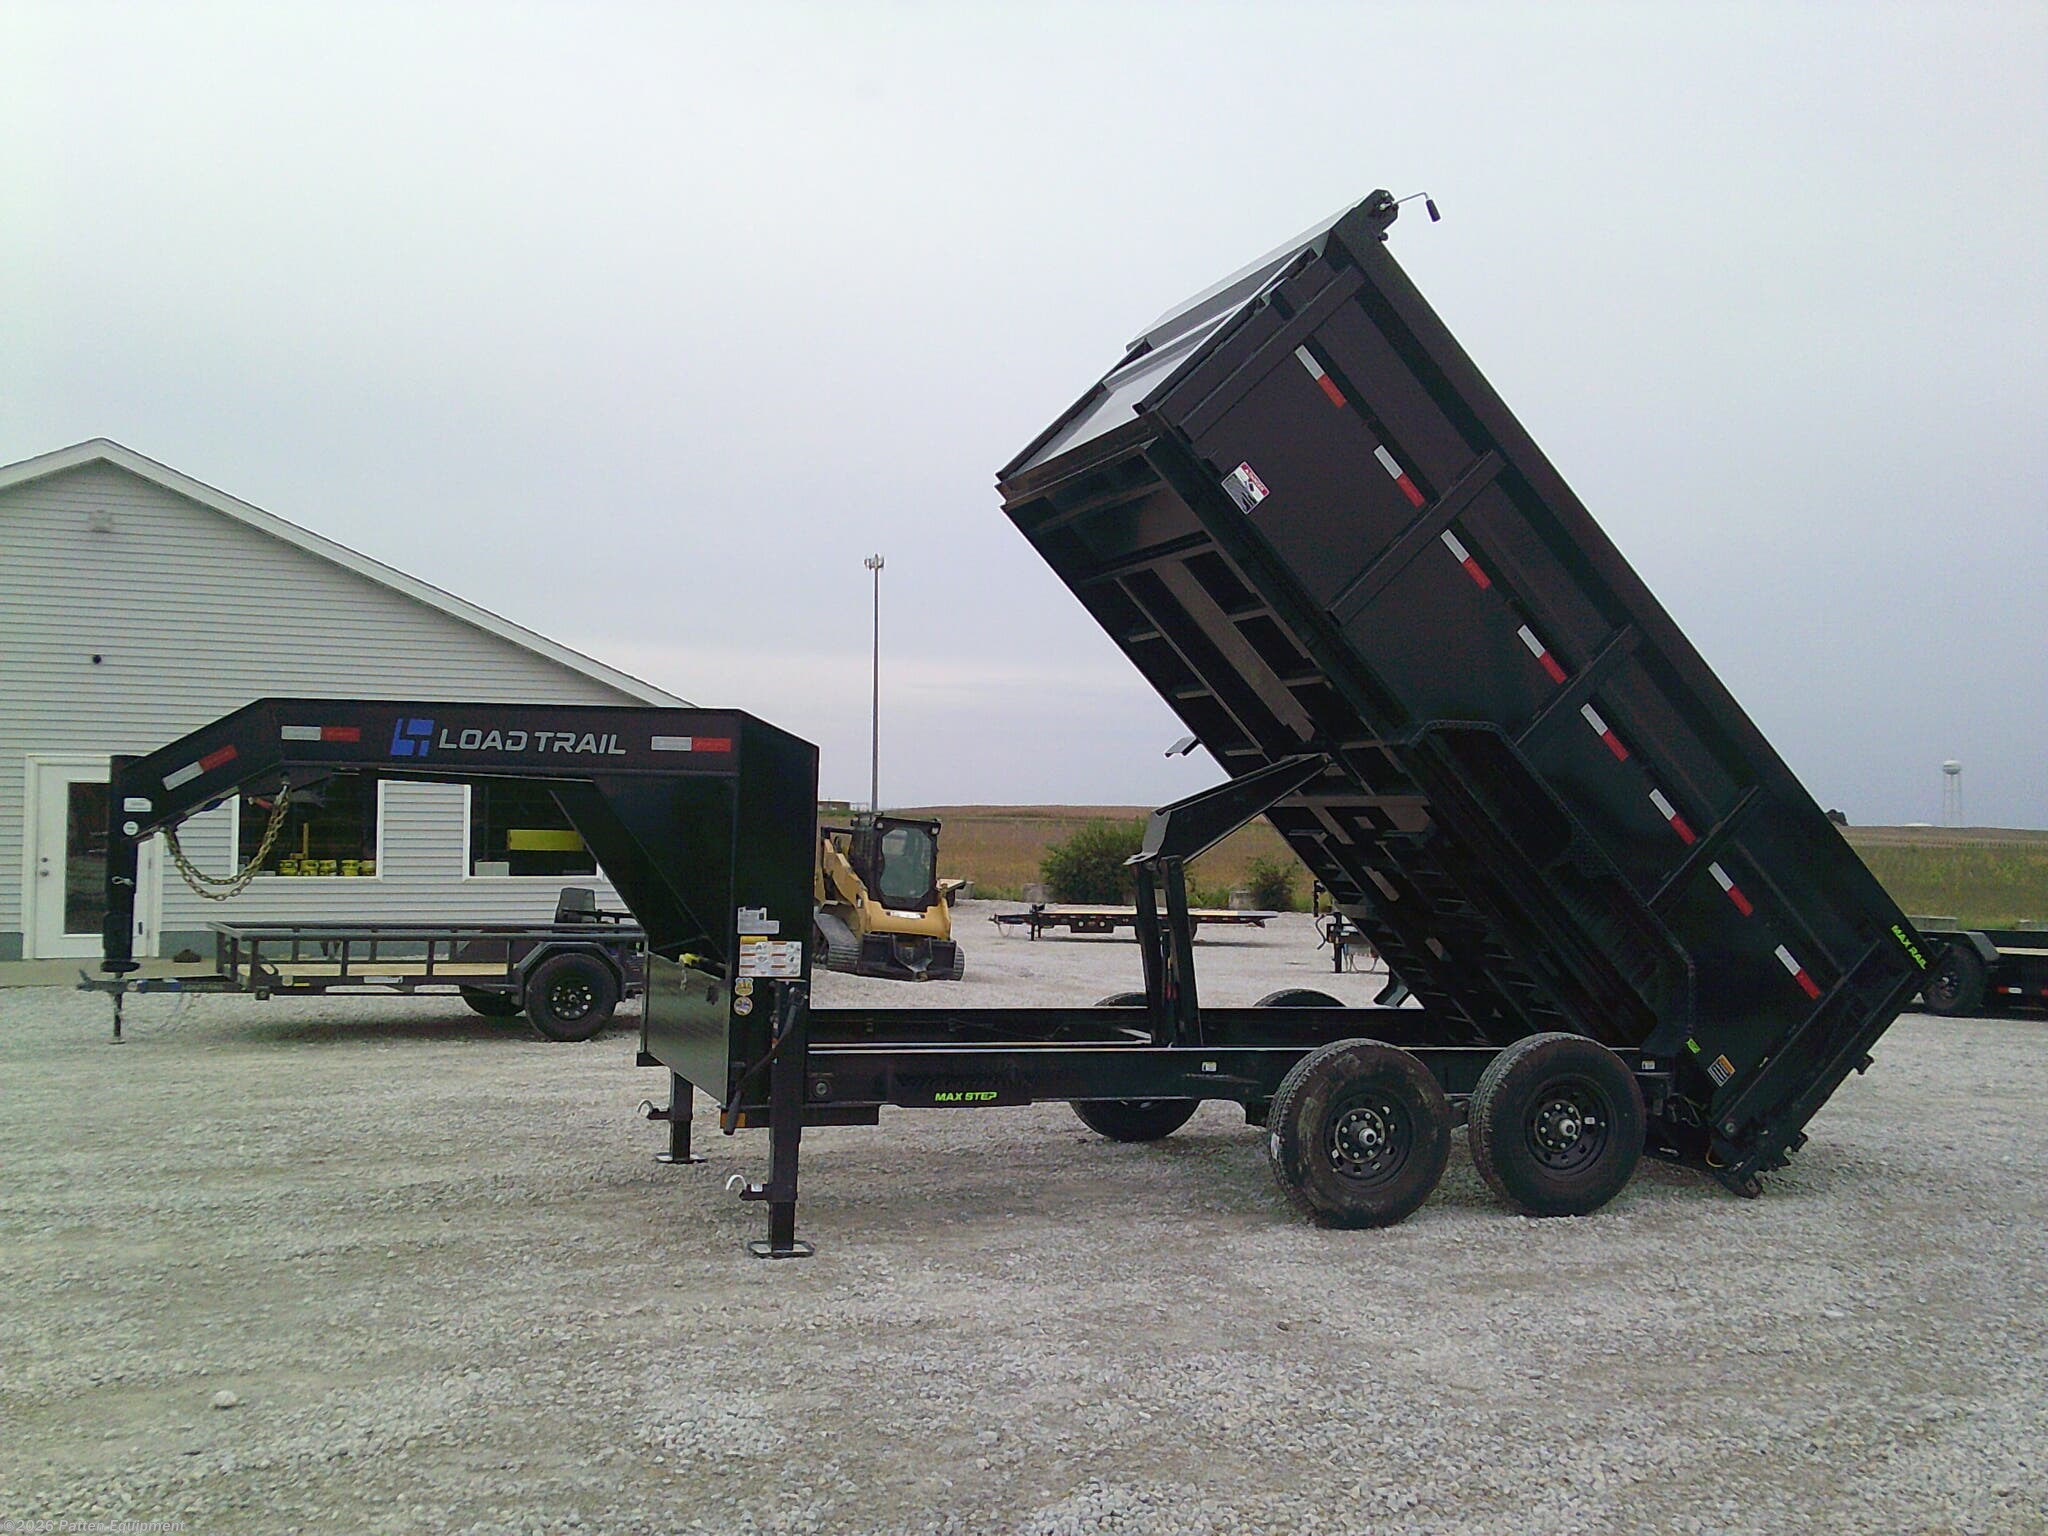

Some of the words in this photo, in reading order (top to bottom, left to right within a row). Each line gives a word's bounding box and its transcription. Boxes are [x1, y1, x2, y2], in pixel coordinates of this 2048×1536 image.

[438, 729, 528, 750] LOAD
[534, 731, 626, 754] TRAIL
[1891, 925, 1911, 948] MAX
[935, 1092, 963, 1101] MAX
[965, 1091, 997, 1101] STEP
